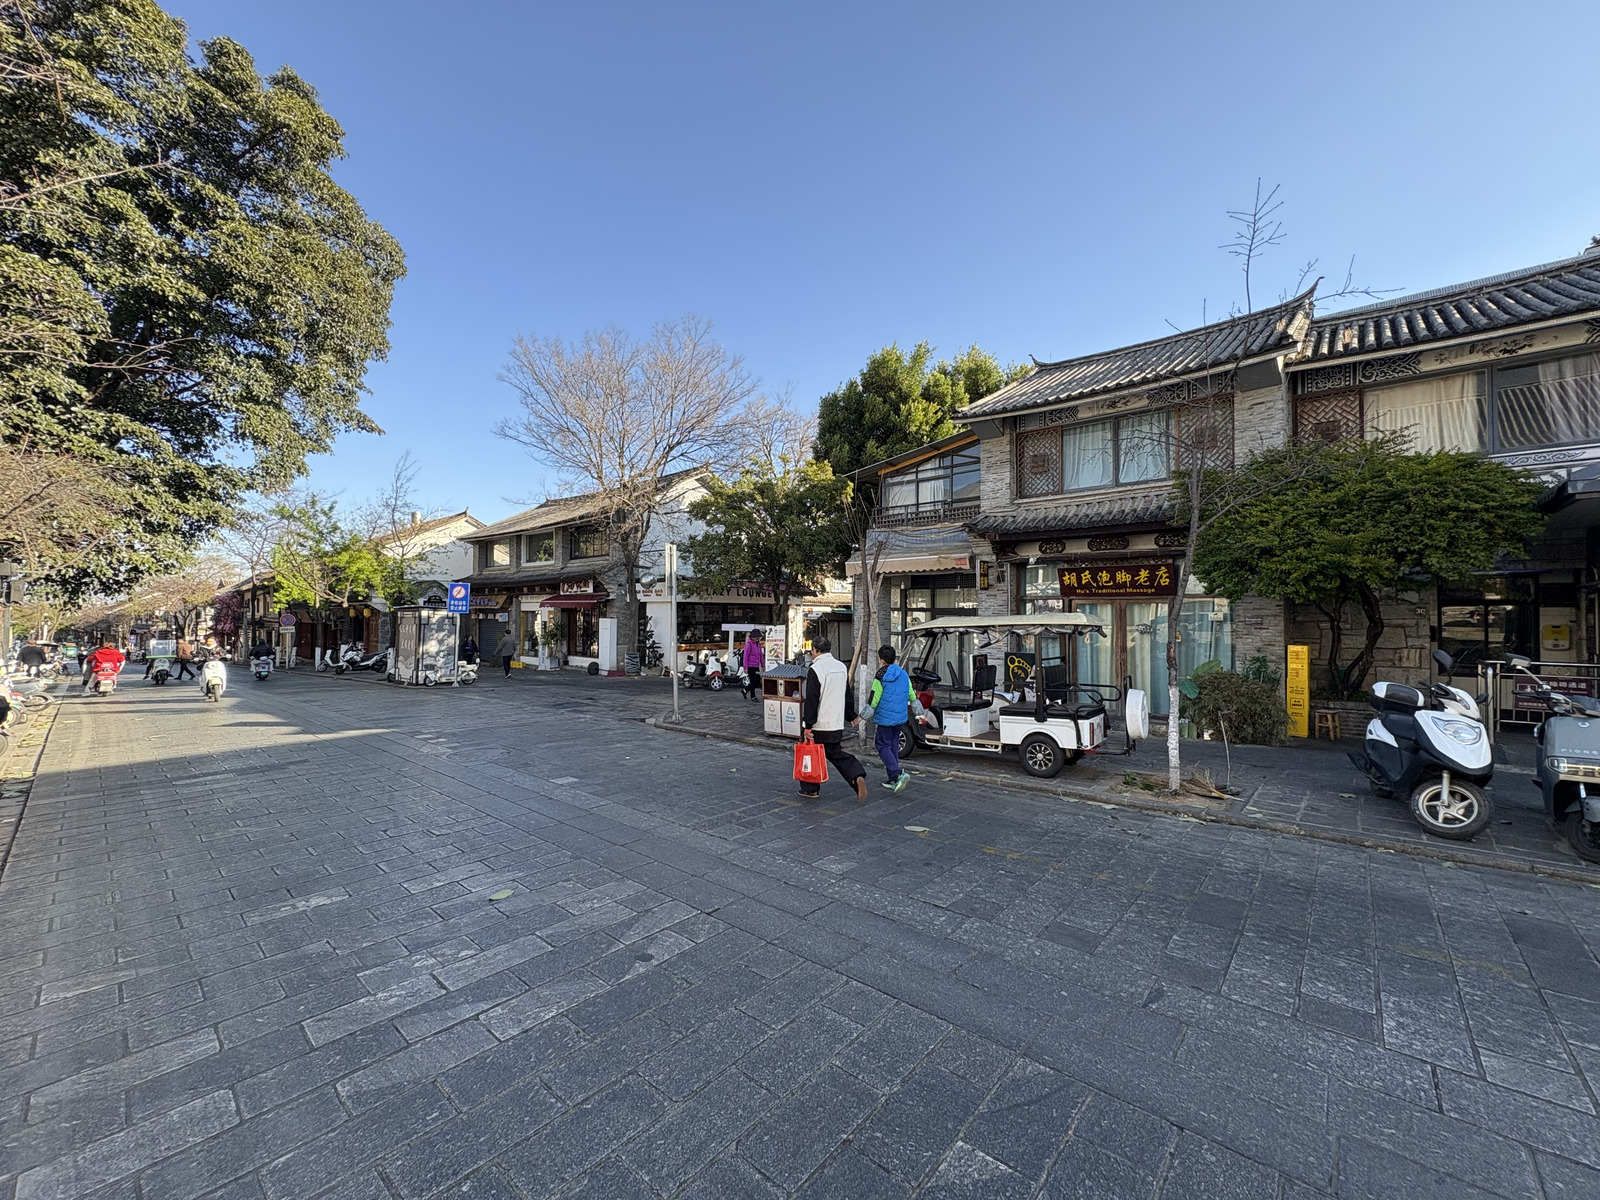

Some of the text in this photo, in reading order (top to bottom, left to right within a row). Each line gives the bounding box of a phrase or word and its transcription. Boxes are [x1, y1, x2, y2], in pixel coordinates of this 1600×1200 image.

[1062, 566, 1170, 588] 胡氏泡脚老店
[736, 588, 772, 598] LOUNGE
[1013, 666, 1025, 678] SPA
